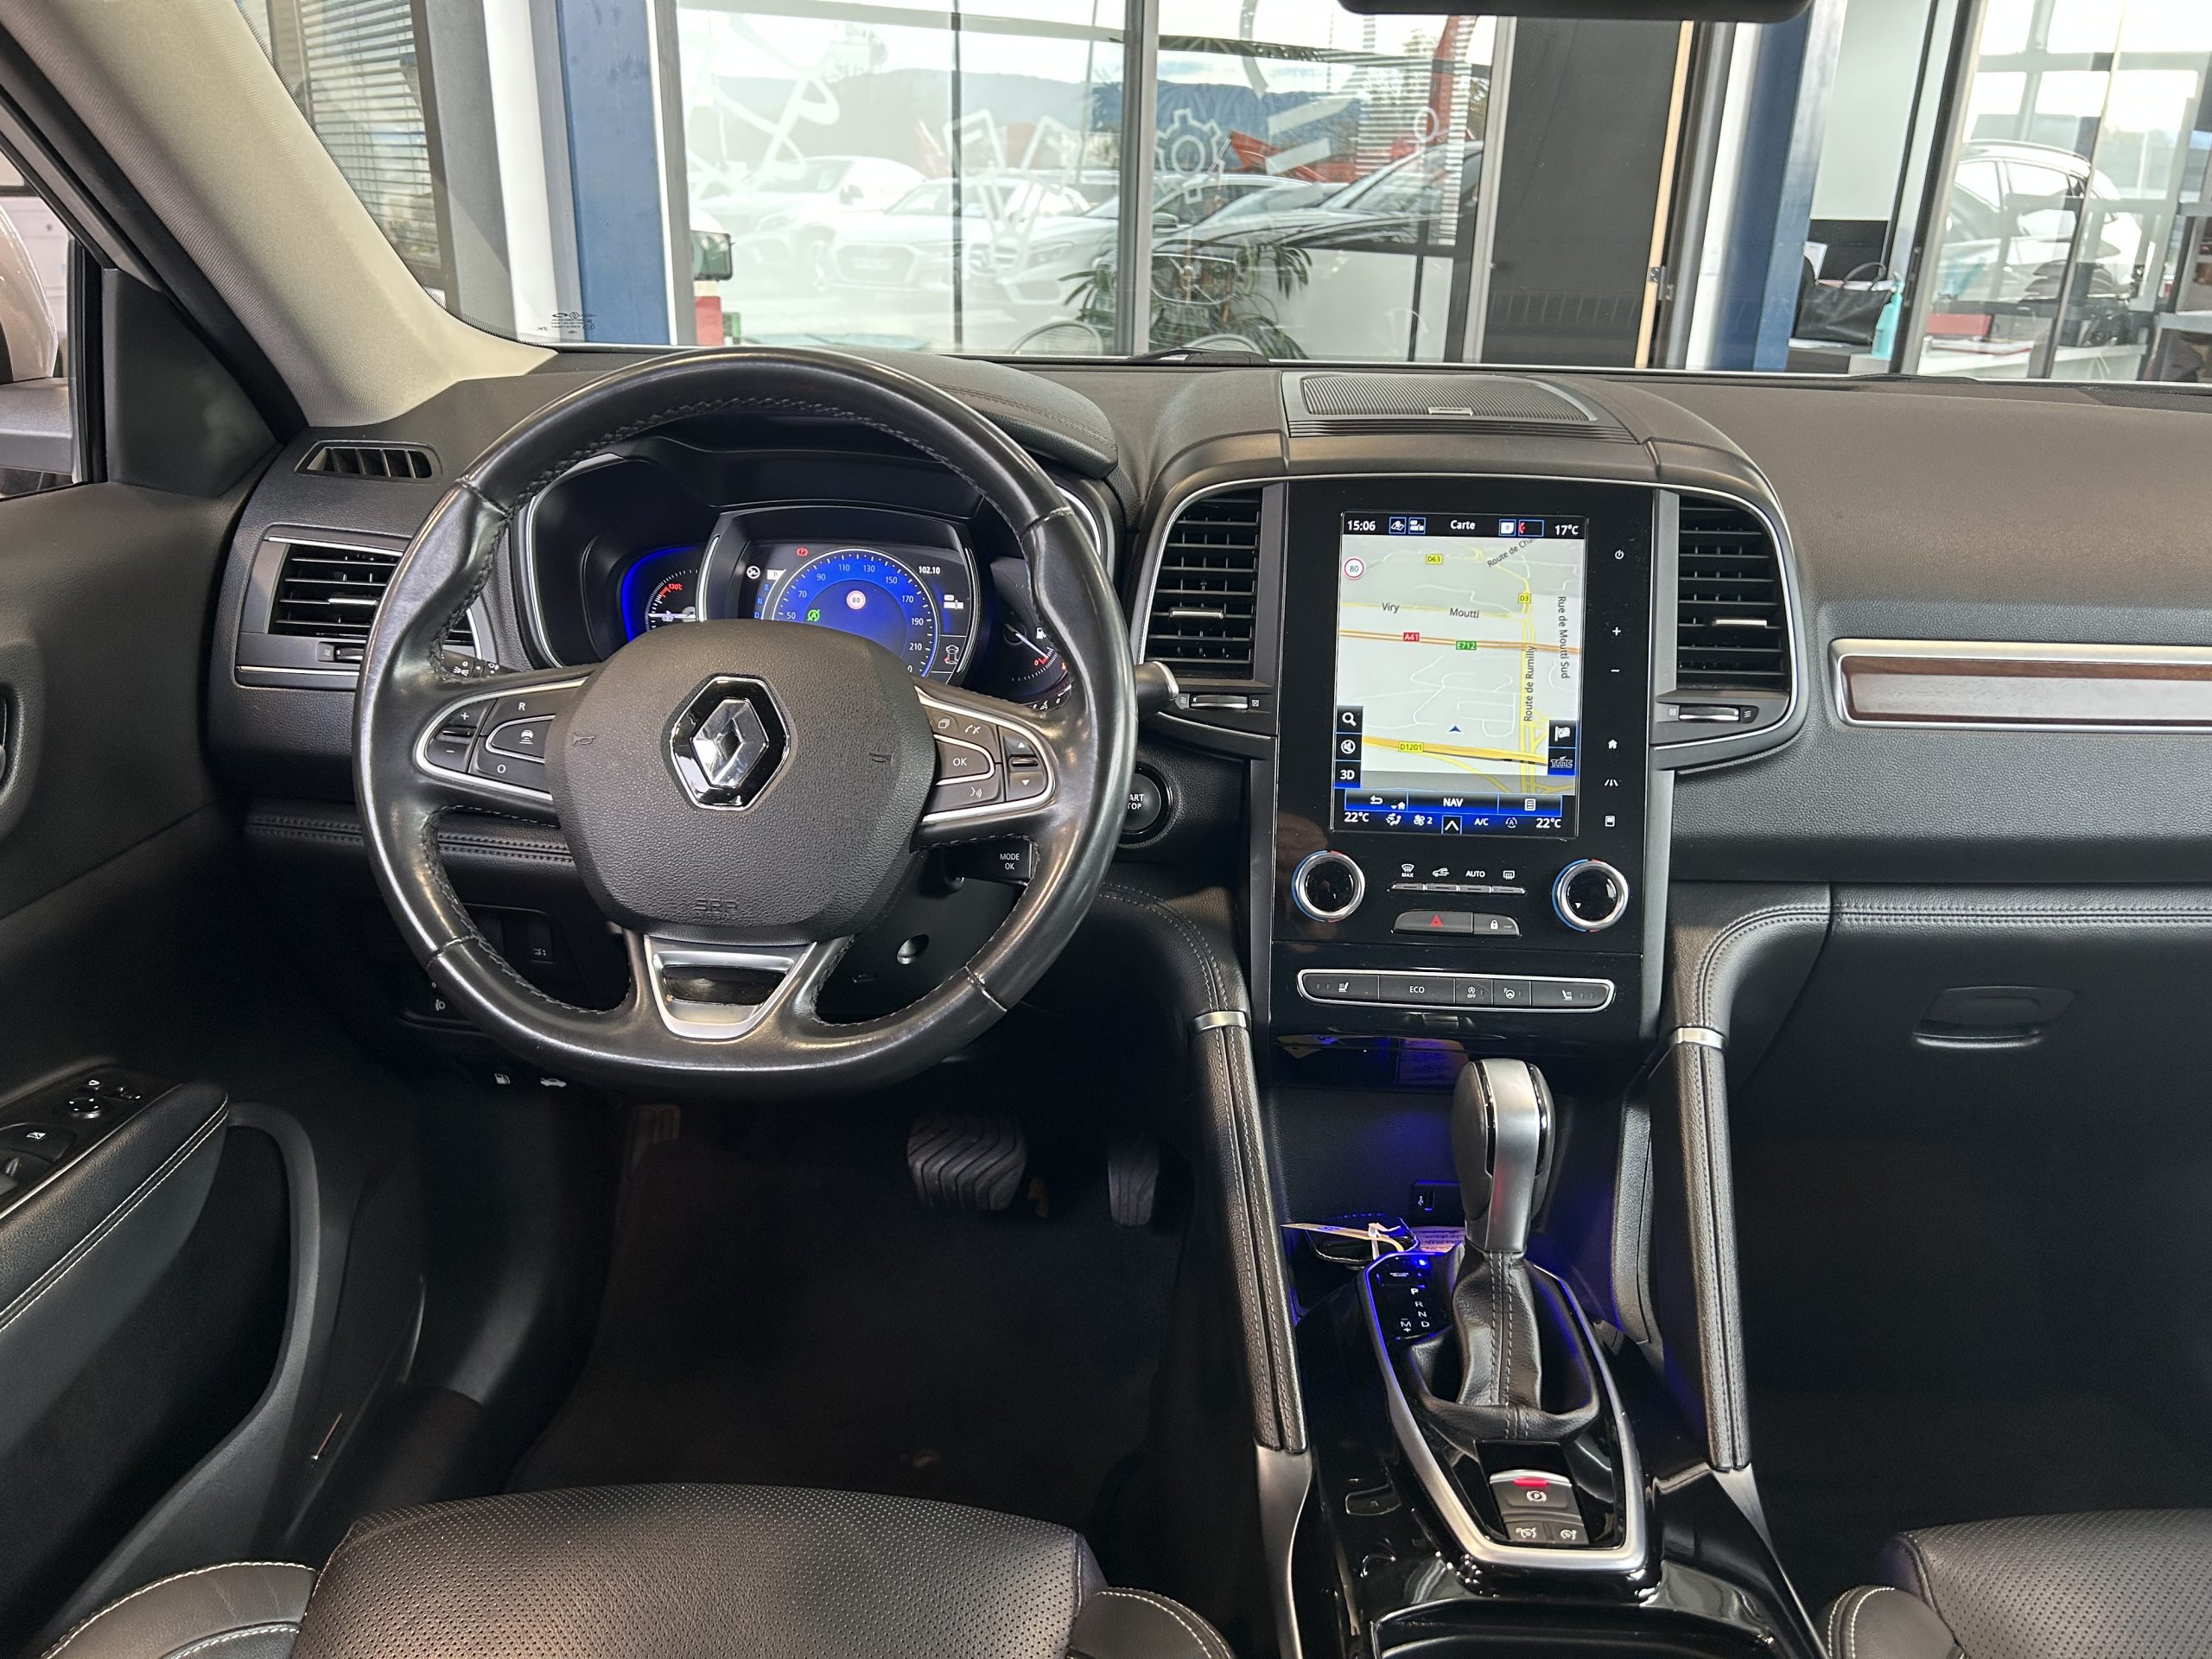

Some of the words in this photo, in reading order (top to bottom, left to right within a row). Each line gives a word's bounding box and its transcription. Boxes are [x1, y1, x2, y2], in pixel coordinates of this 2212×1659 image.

[1347, 520, 1376, 531] 15:06
[1450, 519, 1476, 530] Carte
[1554, 524, 1580, 536] 17°C
[1486, 551, 1509, 568] Route
[1509, 545, 1519, 555] de
[1518, 537, 1535, 548] Cha
[838, 563, 851, 572] 110
[863, 564, 875, 573] 130
[918, 565, 941, 575] 102.10
[1349, 564, 1359, 573] 80
[816, 573, 826, 582] 90
[885, 575, 898, 584] 150
[901, 594, 914, 603] 170
[1382, 602, 1400, 613] Viry
[1557, 595, 1567, 613] Rue
[786, 611, 797, 620] 50
[1449, 607, 1479, 619] Moutti
[1558, 614, 1567, 627] de
[909, 643, 923, 652] 210
[1559, 629, 1569, 660] Moutti
[1525, 645, 1537, 680] Rumilly
[1560, 661, 1571, 679] Sud
[1525, 683, 1535, 695] de
[518, 702, 526, 711] R
[1524, 696, 1535, 721] Route
[952, 757, 968, 766] OK
[1339, 769, 1355, 780] 3D
[1128, 793, 1146, 802] ART
[1127, 802, 1142, 810] TOP
[1443, 798, 1464, 807] NAV
[1344, 811, 1370, 823] 22°C
[1427, 817, 1433, 825] 2
[1474, 817, 1490, 826] A/C
[1535, 817, 1562, 829] 22°C
[999, 853, 1020, 861] MODE
[1005, 862, 1014, 871] OK
[1409, 985, 1425, 994] ECO
